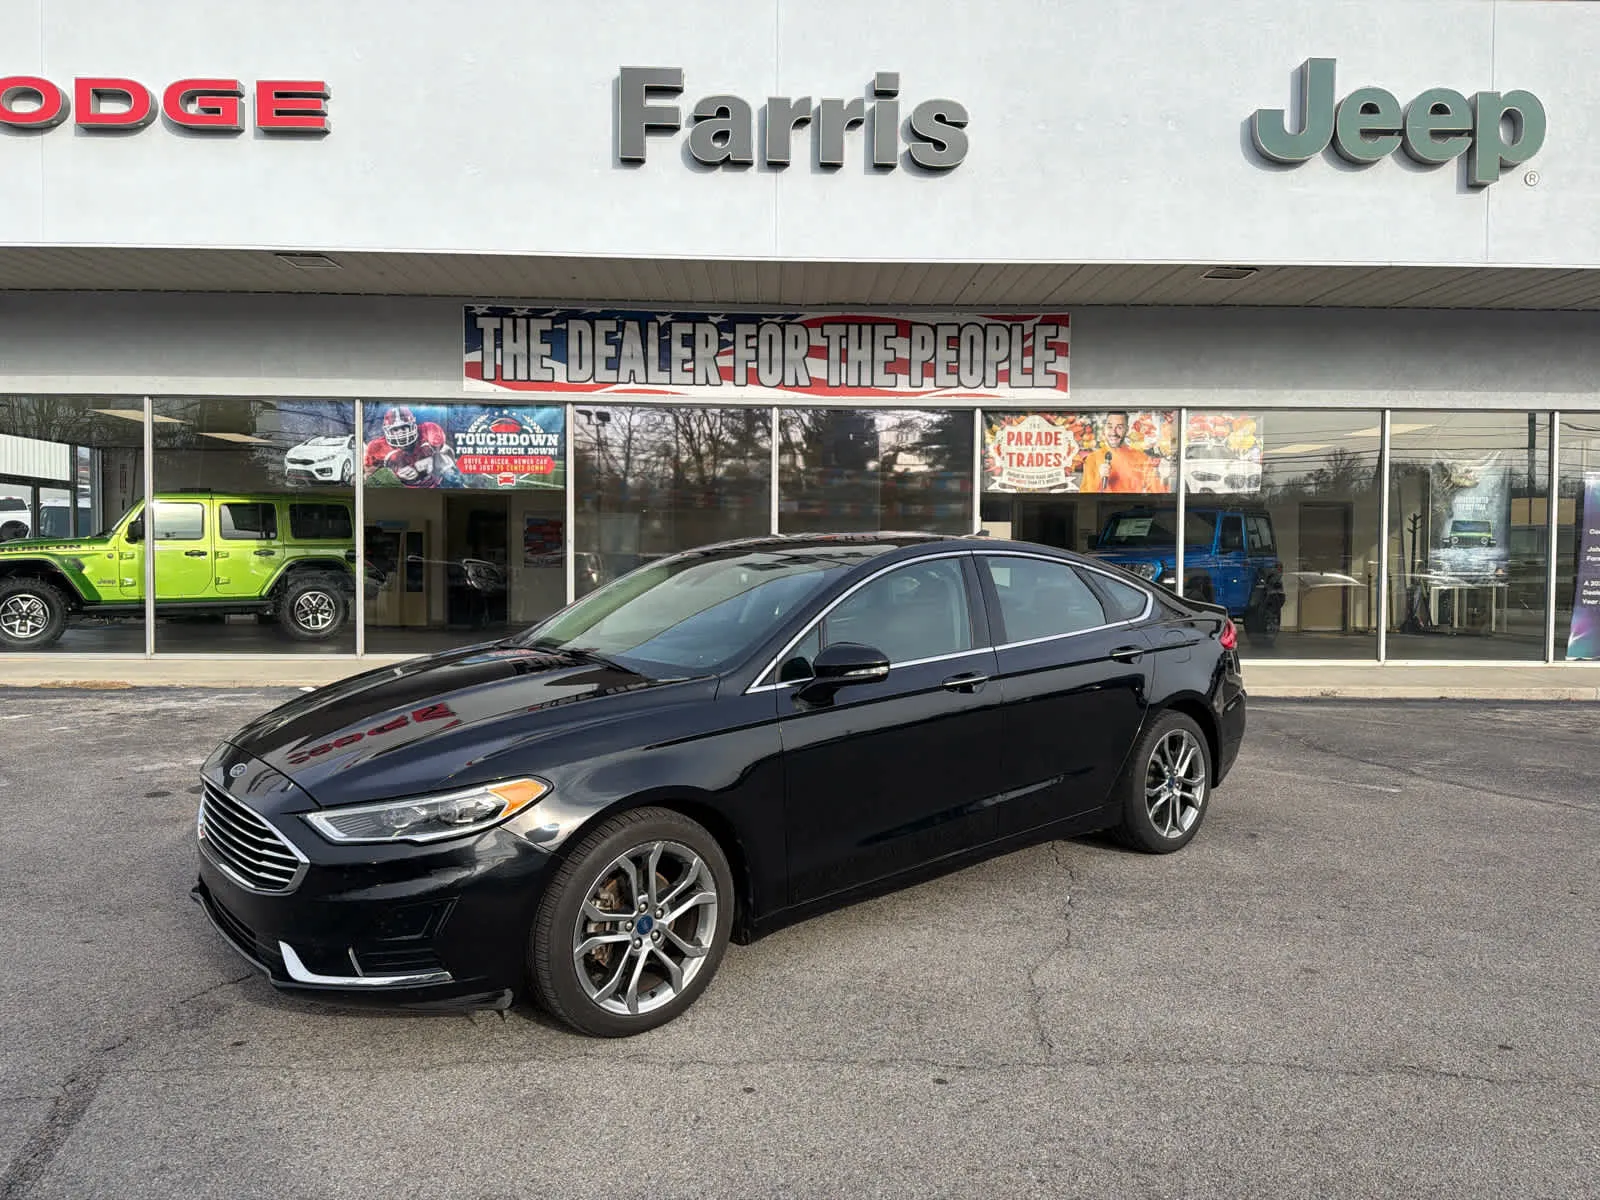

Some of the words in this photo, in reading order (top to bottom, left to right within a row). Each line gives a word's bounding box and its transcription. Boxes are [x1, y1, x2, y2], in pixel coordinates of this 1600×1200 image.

[616, 65, 970, 172] Farris
[1252, 57, 1547, 187] Jeep
[475, 316, 555, 382] THE
[567, 318, 723, 386] DEALER
[732, 321, 812, 388] FOR
[820, 322, 898, 388] THE
[908, 322, 1059, 389] PEOPLE
[454, 433, 559, 446] TOUCHDOWN
[1007, 431, 1062, 446] PARADE
[456, 447, 474, 455] FOR
[476, 447, 495, 455] NOT
[498, 447, 525, 455] MUCH
[528, 447, 558, 455] DOWN!
[1006, 452, 1062, 467] TRADES
